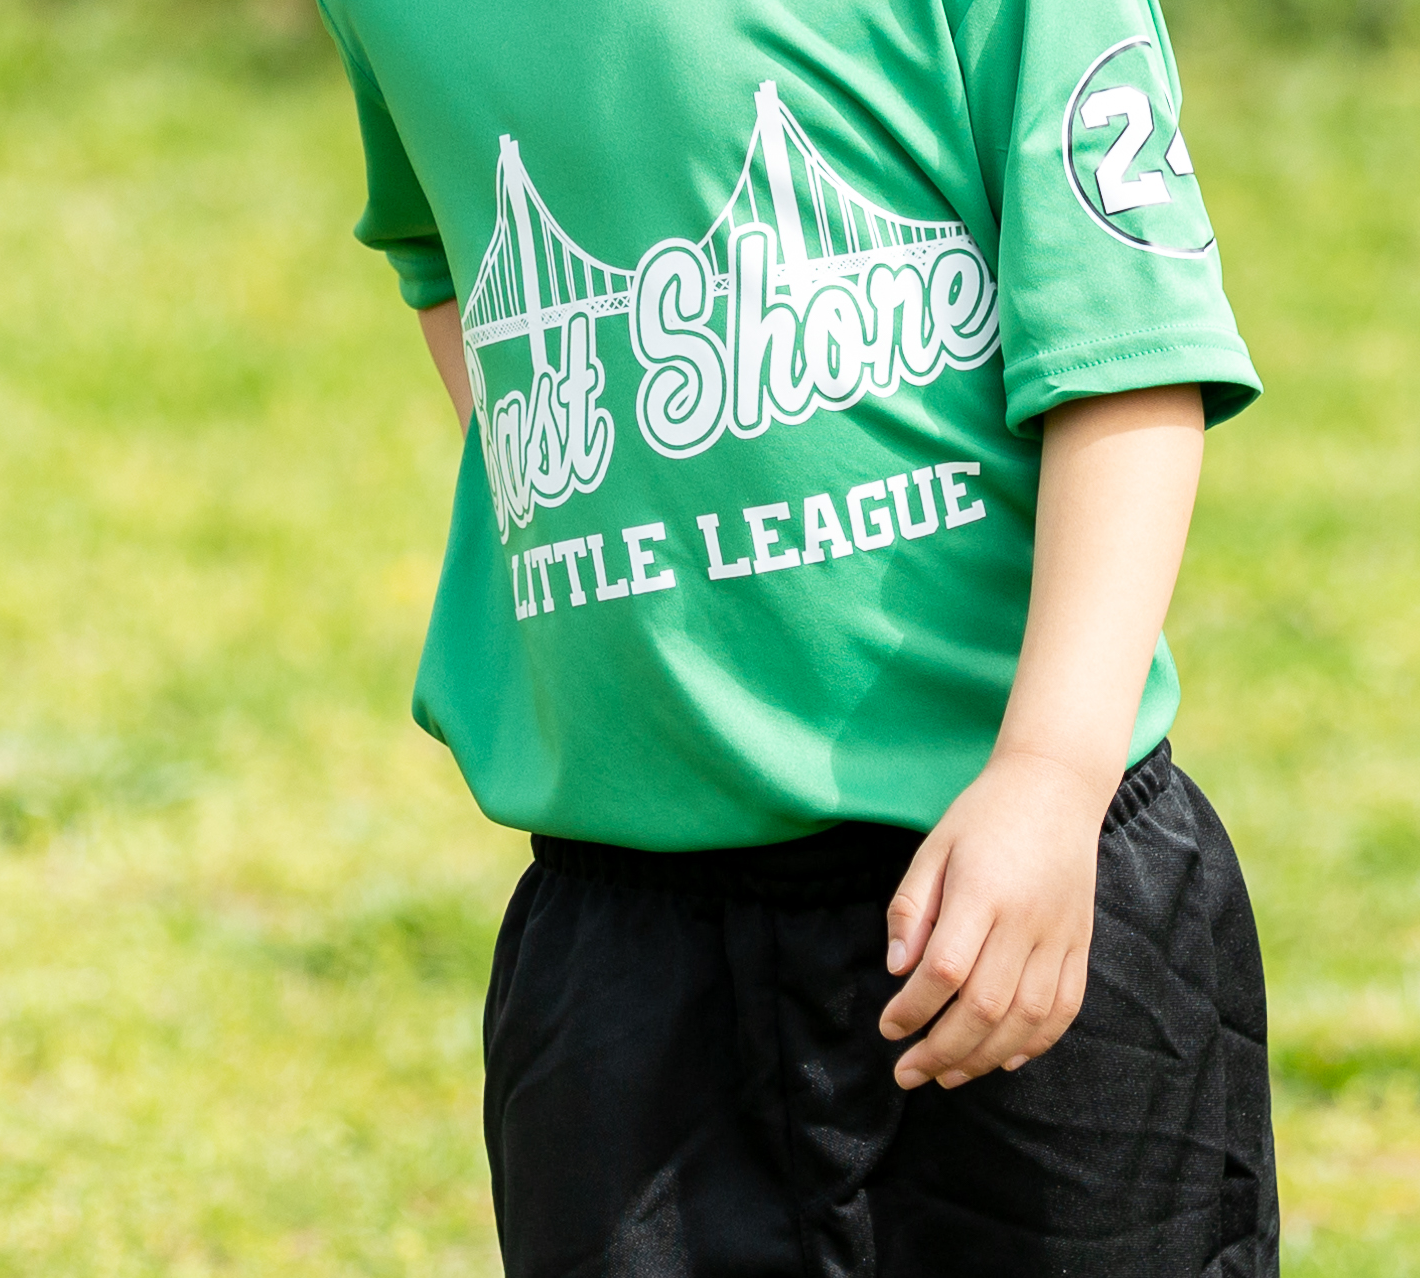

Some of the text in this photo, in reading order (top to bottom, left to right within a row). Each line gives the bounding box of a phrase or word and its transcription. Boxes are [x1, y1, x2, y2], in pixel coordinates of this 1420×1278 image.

[628, 221, 1003, 460] Shore
[510, 461, 987, 622] LITTLE LEAGUE
